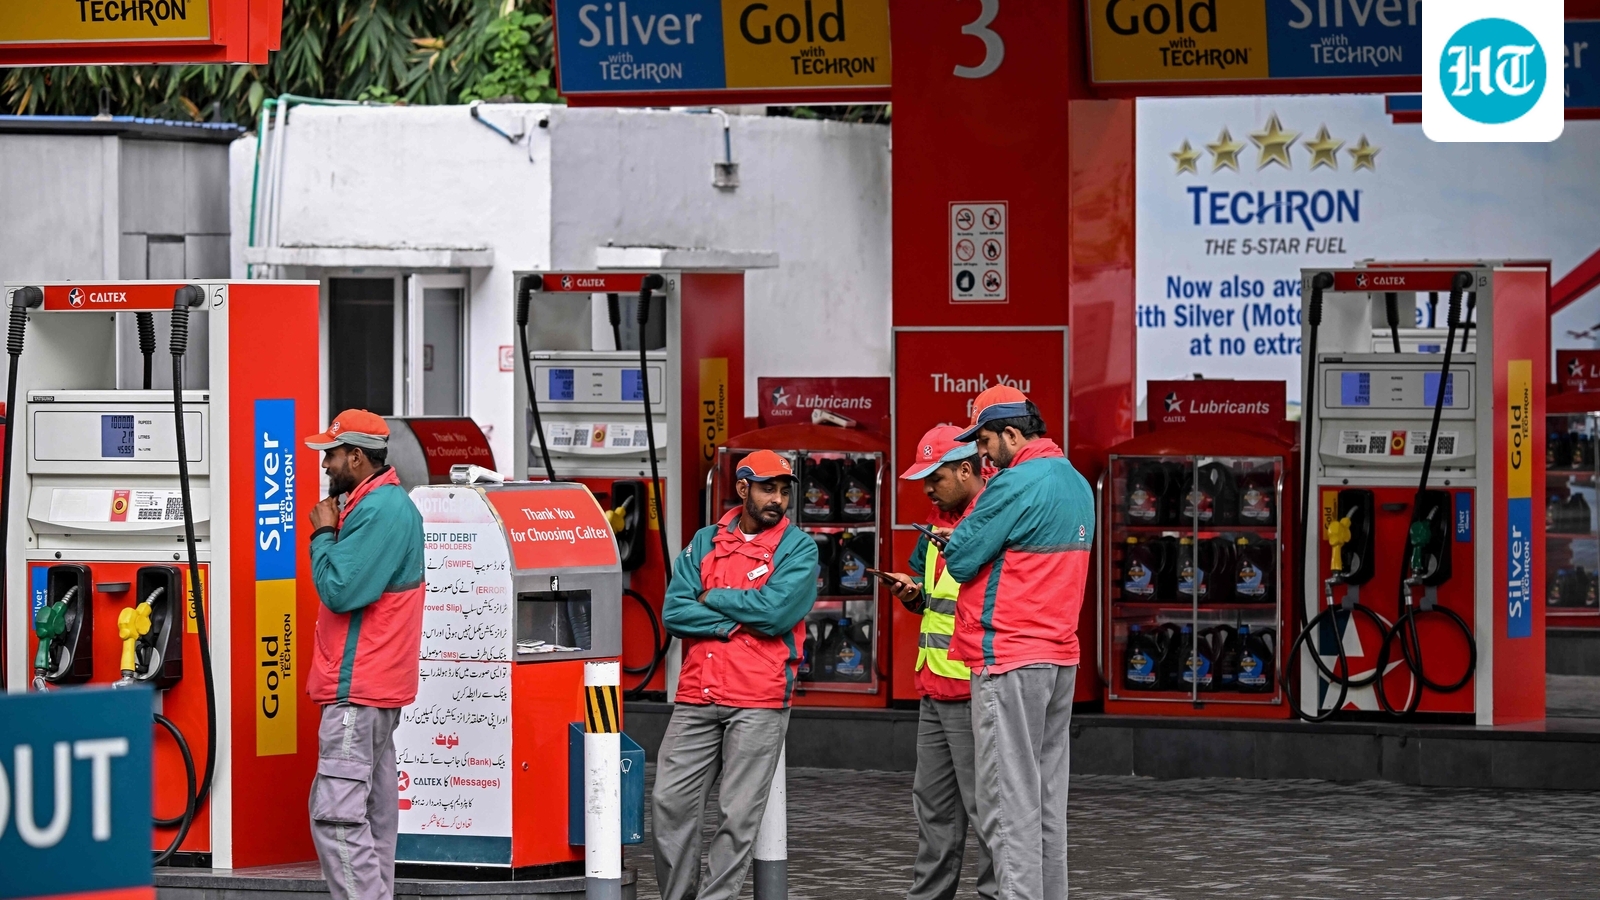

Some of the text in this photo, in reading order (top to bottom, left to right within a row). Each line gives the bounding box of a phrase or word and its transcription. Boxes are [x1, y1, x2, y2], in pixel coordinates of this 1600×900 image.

[579, 1, 702, 47] Silver
[740, 0, 846, 45] Gold
[1106, 0, 1218, 36] Gold
[953, 0, 1005, 78] 3
[1170, 37, 1196, 48] with
[1320, 34, 1348, 46] with
[609, 52, 633, 62] with
[800, 46, 825, 58] with
[1159, 47, 1249, 68] TECHRON
[1310, 44, 1402, 66] TECHRON
[600, 61, 682, 84] TECHRON
[791, 56, 876, 78] TECHRON
[1187, 186, 1360, 231] TECHRON
[1205, 237, 1346, 255] THE 5-STAR FUEL
[577, 278, 604, 287] CALTEX
[1167, 276, 1212, 299] Now
[1220, 275, 1264, 298] also
[1374, 276, 1405, 286] CALTEX
[90, 292, 128, 303] CALTEX
[214, 287, 224, 306] 5
[1137, 303, 1302, 332] ith Silver (Moto
[1190, 334, 1212, 356] at
[1220, 337, 1246, 355] no
[931, 373, 1031, 393] Thank You
[796, 394, 872, 409] Lubricants
[1190, 400, 1270, 414] Lubricants
[432, 432, 468, 442] Thank You
[703, 400, 716, 462] Gold
[1511, 404, 1522, 470] Gold
[426, 446, 490, 460] for Choosing Caltex
[258, 432, 280, 551] Silver
[284, 454, 294, 532] TECHRON
[521, 508, 575, 520] Thank You
[424, 533, 478, 542] REDIT DEBIT
[510, 526, 608, 544] for Choosing Caltex
[445, 560, 474, 569] (SWIPE)
[1509, 525, 1522, 618] Silver
[476, 586, 507, 595] (ERROR)
[34, 590, 42, 616] ilver
[446, 604, 462, 612] Slip)
[283, 614, 292, 680] TECHRON
[441, 652, 458, 660] (SMS)
[262, 636, 278, 718] Gold
[468, 758, 492, 768] (Bank)
[414, 778, 442, 786] CALTEX
[450, 777, 500, 789] (Messages)
[0, 737, 129, 849] UT
